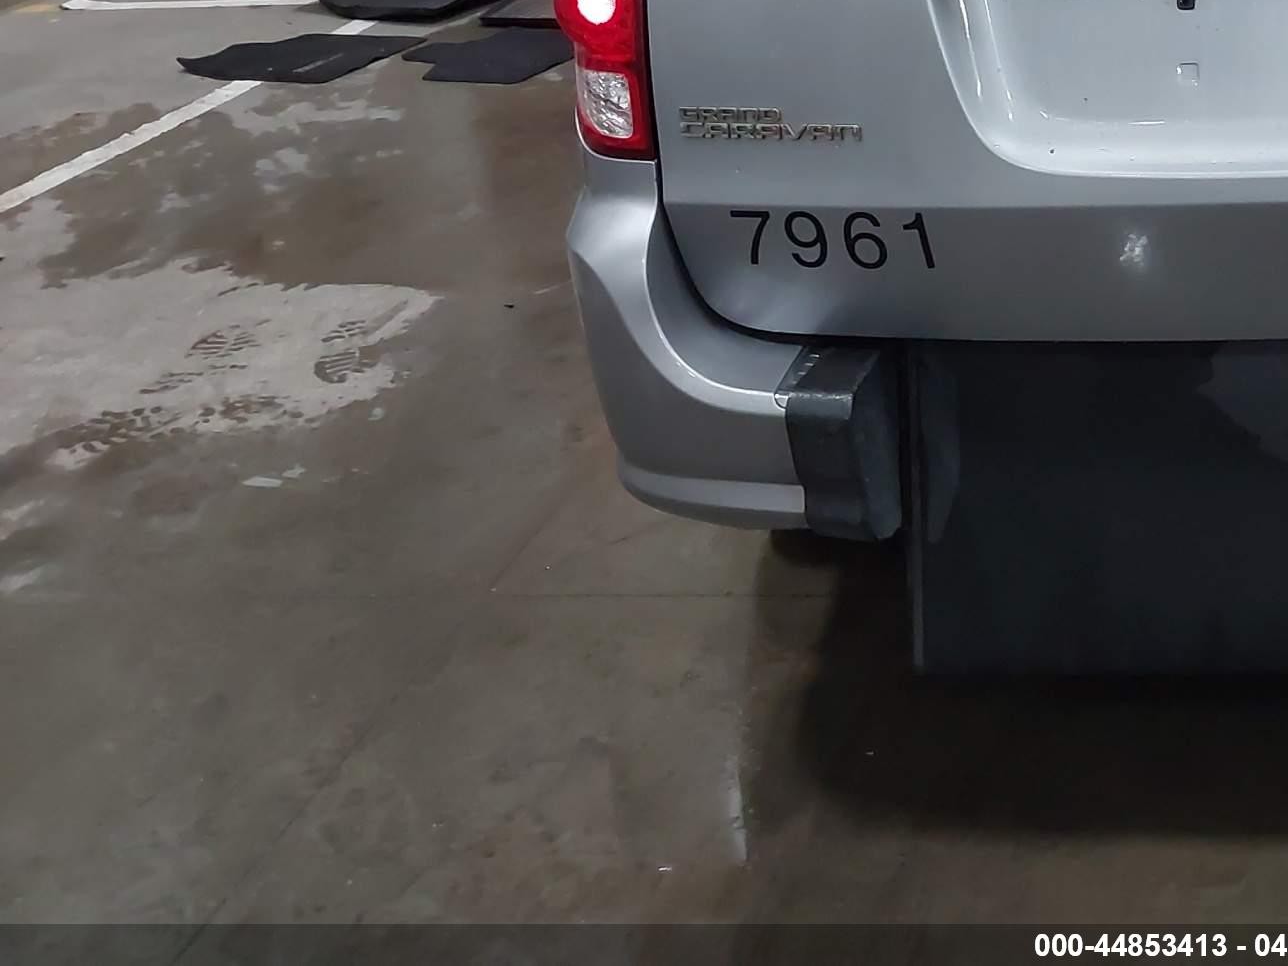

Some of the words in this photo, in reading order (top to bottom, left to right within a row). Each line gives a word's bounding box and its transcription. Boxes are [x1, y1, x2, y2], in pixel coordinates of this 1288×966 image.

[679, 106, 783, 123] GRAND
[679, 122, 863, 142] CARAVAN
[730, 210, 935, 270] 7961
